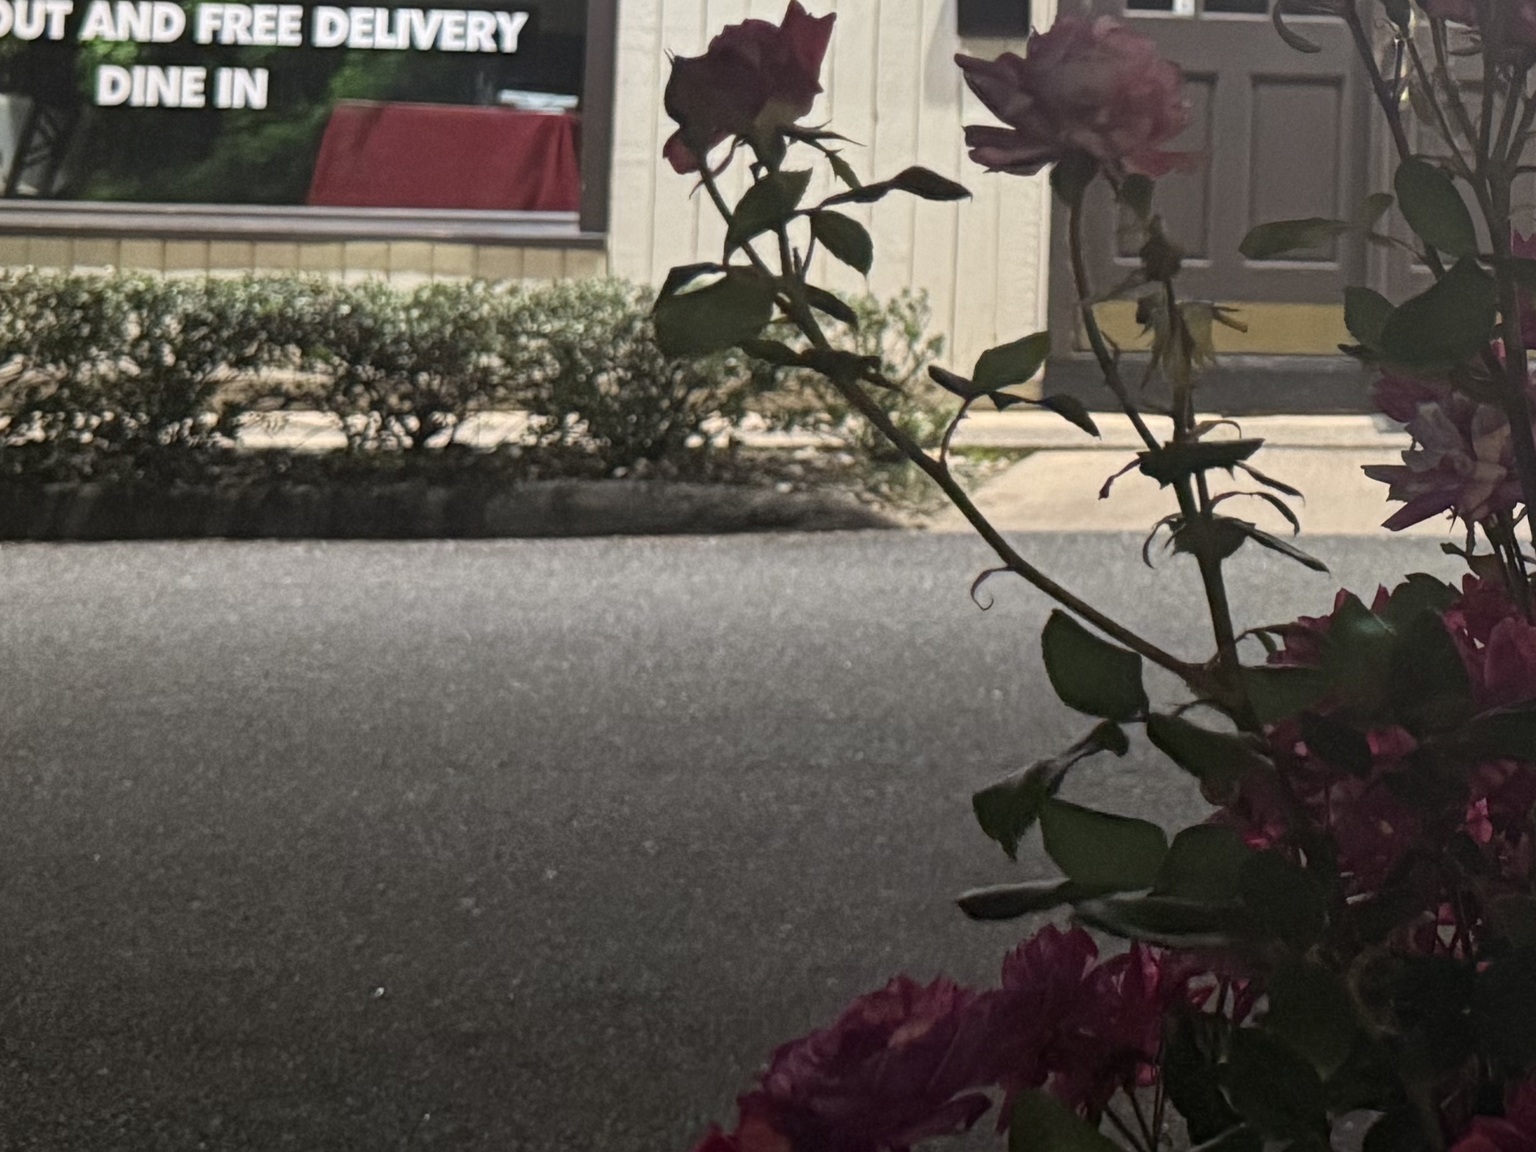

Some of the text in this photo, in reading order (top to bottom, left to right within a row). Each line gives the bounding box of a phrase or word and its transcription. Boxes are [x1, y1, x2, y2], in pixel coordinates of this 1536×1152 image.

[77, 0, 187, 43] AND
[195, 3, 303, 46] FREE
[311, 6, 529, 53] DELIVERY
[95, 64, 269, 110] DINE IN
